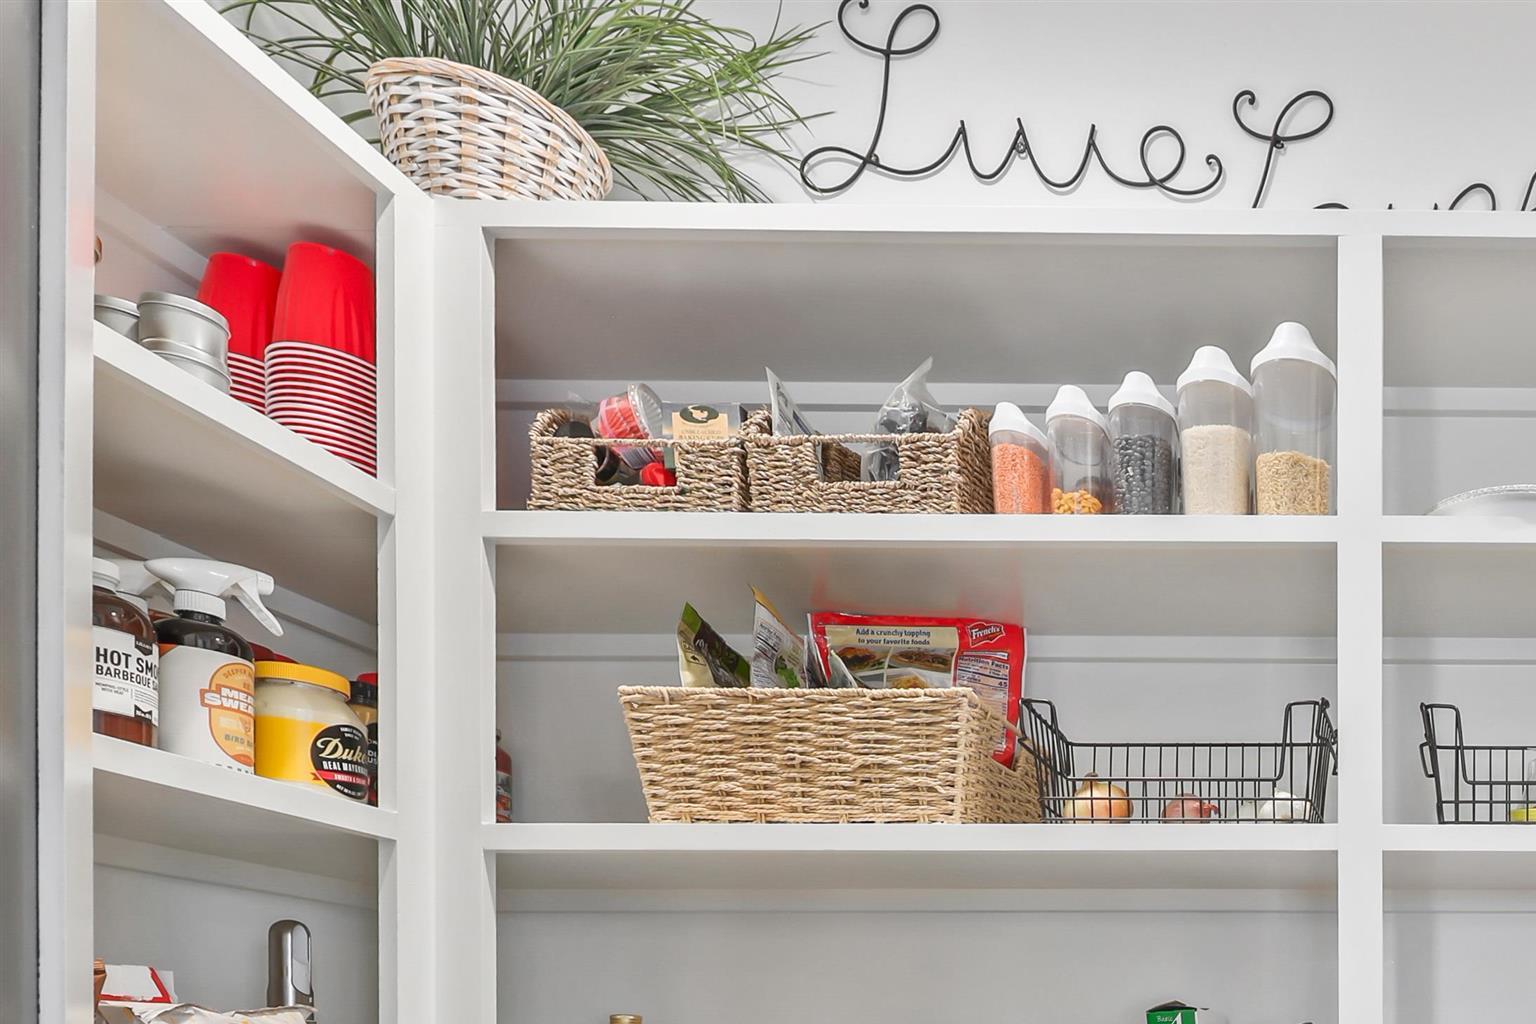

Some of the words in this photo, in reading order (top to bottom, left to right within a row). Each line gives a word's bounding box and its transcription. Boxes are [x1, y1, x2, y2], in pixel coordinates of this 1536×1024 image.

[856, 628, 869, 636] Add
[875, 630, 903, 638] crunchy
[904, 629, 930, 639] topping
[970, 626, 1002, 641] French's
[96, 646, 132, 669] HOT
[959, 655, 989, 665] Nutrition
[991, 661, 1009, 670] Facts
[96, 664, 151, 689] BARBEQUE
